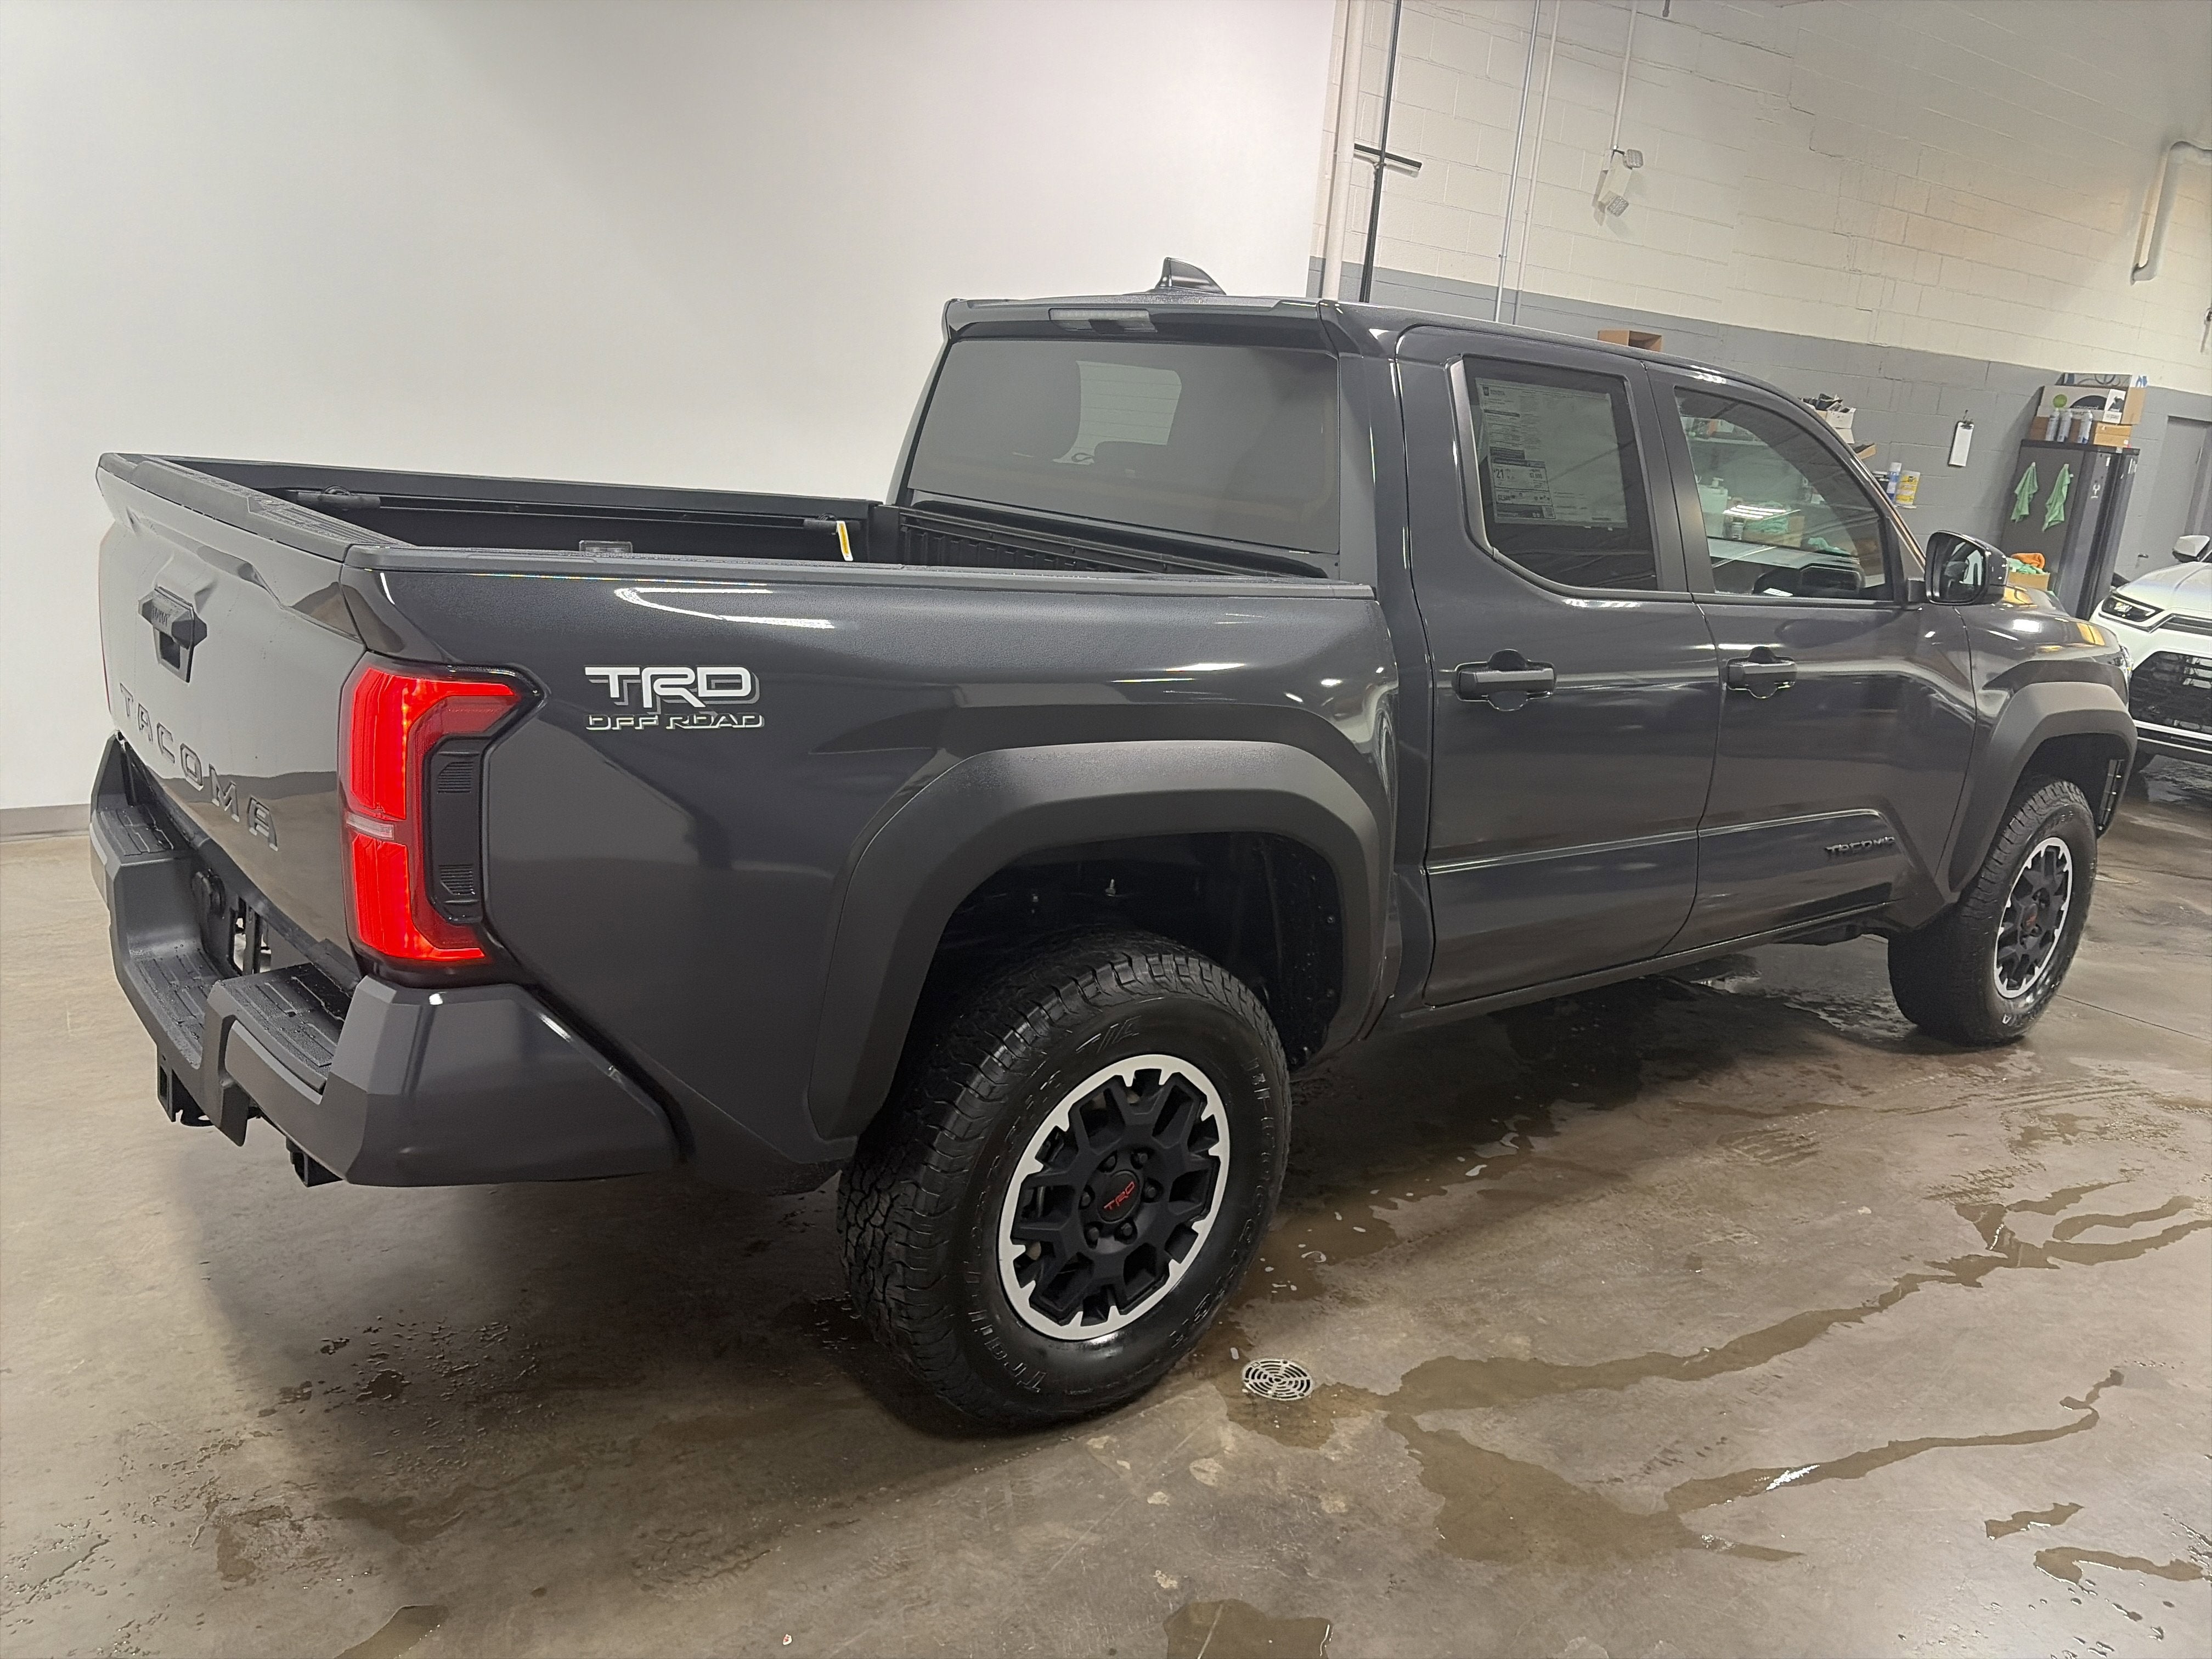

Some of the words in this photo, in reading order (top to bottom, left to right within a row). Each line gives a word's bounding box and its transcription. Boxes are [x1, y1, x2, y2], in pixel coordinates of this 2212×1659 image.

[585, 666, 759, 711] TRD
[585, 714, 659, 730] OFF
[665, 713, 764, 729] ROAD
[119, 682, 278, 851] TACOMA
[1104, 1181, 1134, 1210] TRD
